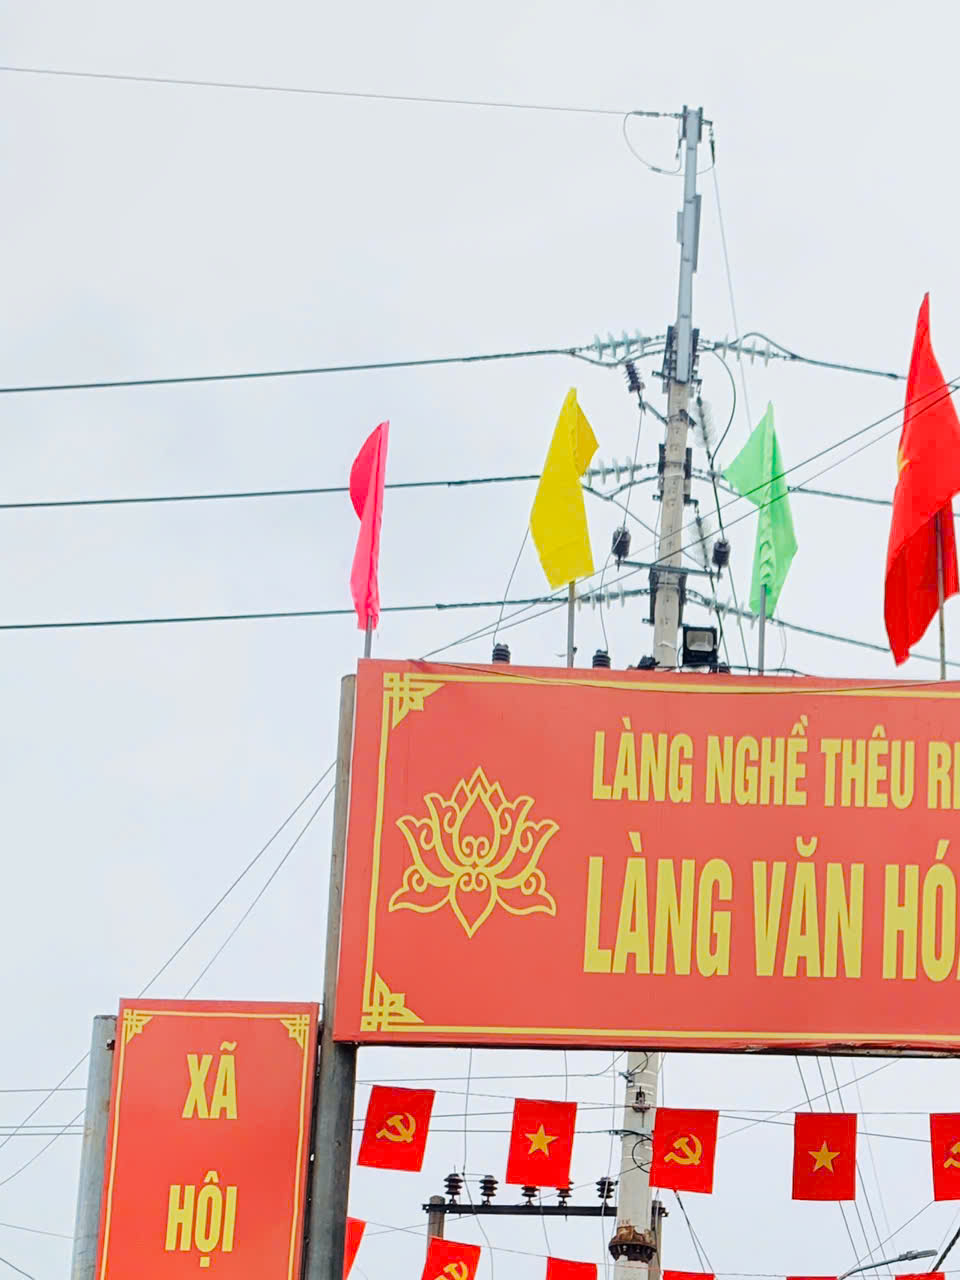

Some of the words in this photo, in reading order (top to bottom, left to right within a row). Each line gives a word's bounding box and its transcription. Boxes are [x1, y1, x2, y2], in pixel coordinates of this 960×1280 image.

[592, 716, 693, 803] LÀNG
[706, 716, 809, 807] NGHỀ
[821, 725, 915, 810] THÊU
[583, 831, 733, 977] LÀNG
[752, 838, 865, 979] VĂN
[182, 1041, 238, 1119] XÃ
[164, 1170, 238, 1267] HỘI
